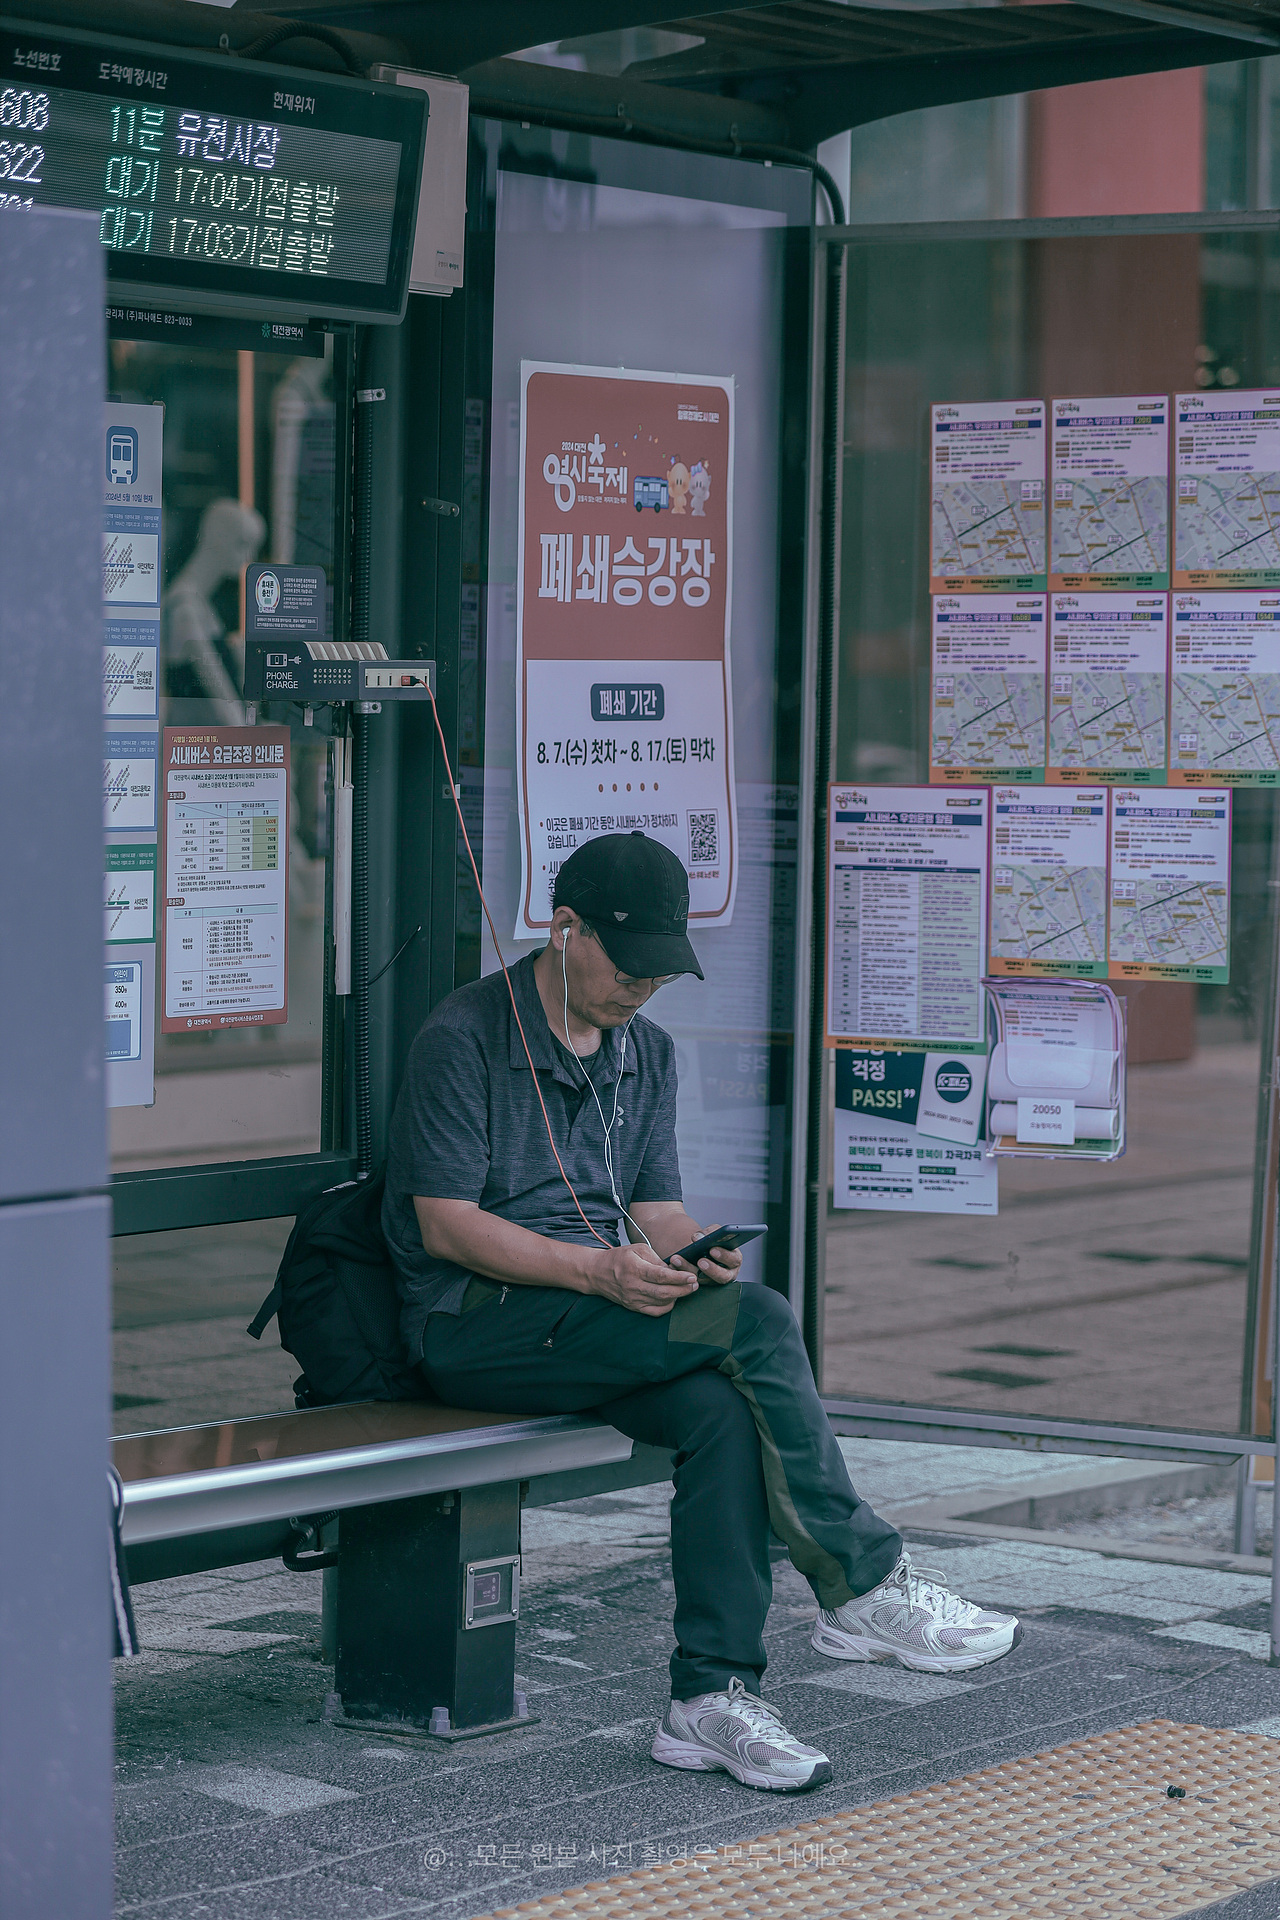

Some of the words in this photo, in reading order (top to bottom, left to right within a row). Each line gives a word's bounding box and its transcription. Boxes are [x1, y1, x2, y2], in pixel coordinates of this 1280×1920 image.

[13, 48, 62, 72] 노선번호
[98, 62, 168, 89] 도착예정시간
[273, 91, 316, 114] 현재위치
[110, 106, 164, 151] 11분
[176, 113, 281, 169] 유천시장
[105, 155, 160, 202] 대기
[99, 206, 154, 252] 대기
[272, 324, 304, 338] 대전광역시
[561, 441, 574, 451] 2024
[574, 442, 587, 453] 대전
[542, 433, 628, 512] 영시축제
[538, 532, 716, 607] 폐쇄승강장
[261, 580, 275, 589] 휴대폰
[266, 671, 293, 680] PHONE
[266, 680, 299, 689] CHARGE
[599, 689, 626, 716] 폐쇄
[630, 689, 657, 716] 기간
[170, 746, 210, 765] 시내버스
[213, 745, 252, 764] 요금조정
[255, 744, 284, 763] 안내문
[591, 738, 617, 764] 첫차
[690, 737, 715, 762] 막차
[546, 817, 568, 832] 이곳은
[584, 816, 599, 831] 기간
[600, 815, 615, 831] 동안
[615, 814, 651, 830] 시내버스가
[863, 812, 899, 823] 시내버스
[547, 834, 579, 849] 않습니다.
[851, 1059, 886, 1081] 걱정
[1032, 1104, 1062, 1115] 20050
[878, 1146, 913, 1157] 두루두루
[945, 1149, 982, 1161] 차곡차곡
[714, 1717, 743, 1742] N
